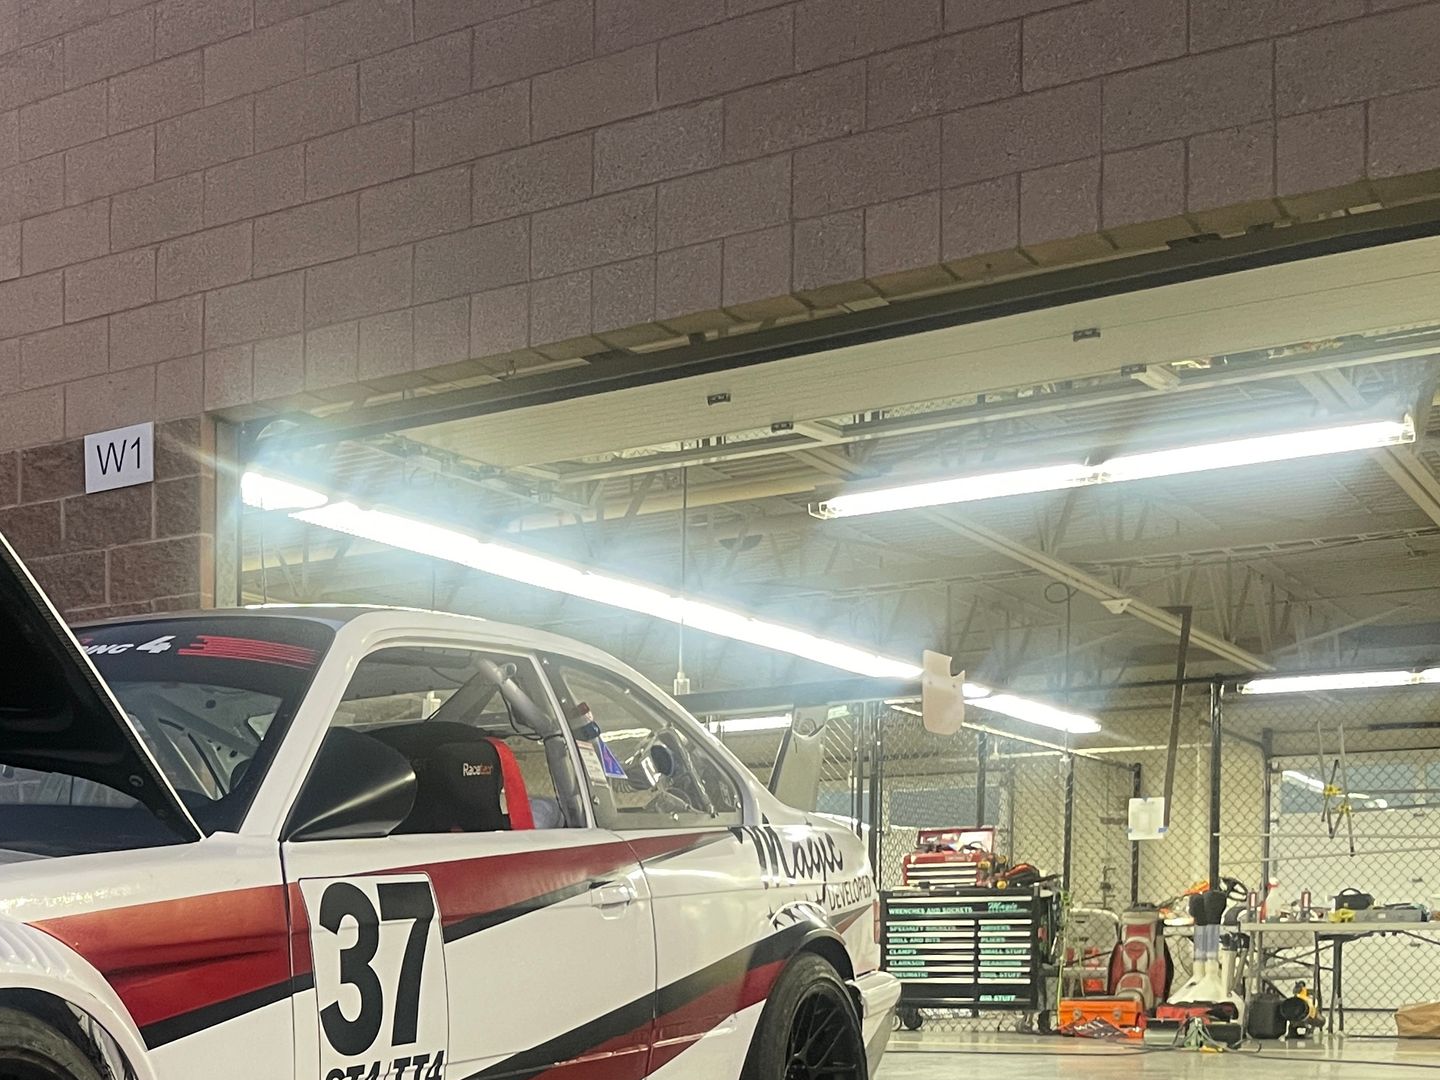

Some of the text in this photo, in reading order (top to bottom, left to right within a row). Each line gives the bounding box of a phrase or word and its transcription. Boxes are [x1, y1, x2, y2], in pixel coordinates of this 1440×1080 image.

[97, 437, 140, 475] W1
[136, 635, 176, 654] 4
[319, 882, 435, 1057] 37
